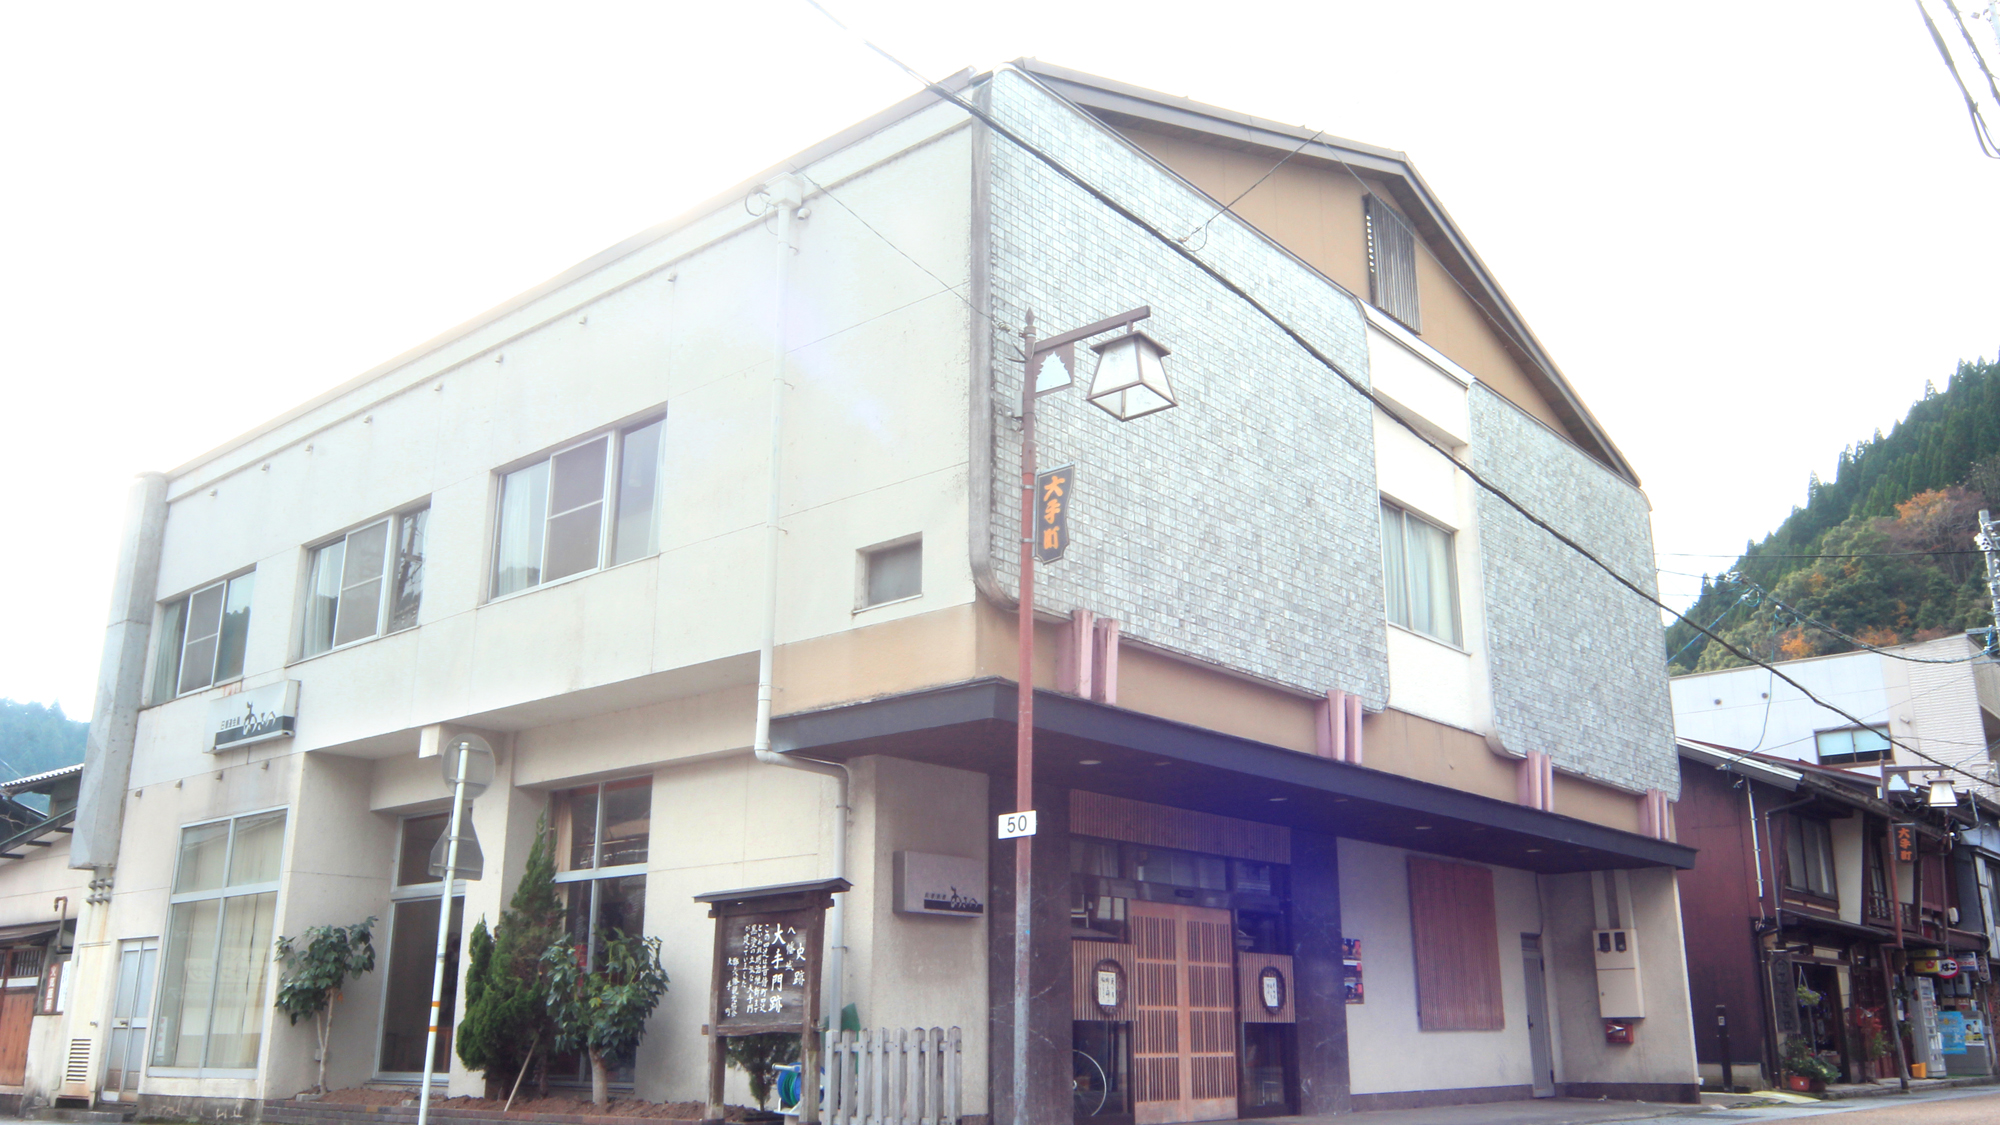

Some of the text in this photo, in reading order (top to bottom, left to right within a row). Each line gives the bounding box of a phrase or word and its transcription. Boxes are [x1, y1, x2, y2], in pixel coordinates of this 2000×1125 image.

[1044, 475, 1065, 549] 大手町
[1007, 815, 1027, 833] 50
[1898, 827, 1912, 860] 大手町
[768, 922, 786, 1013] 大手門跡
[792, 942, 806, 986] 史跡
